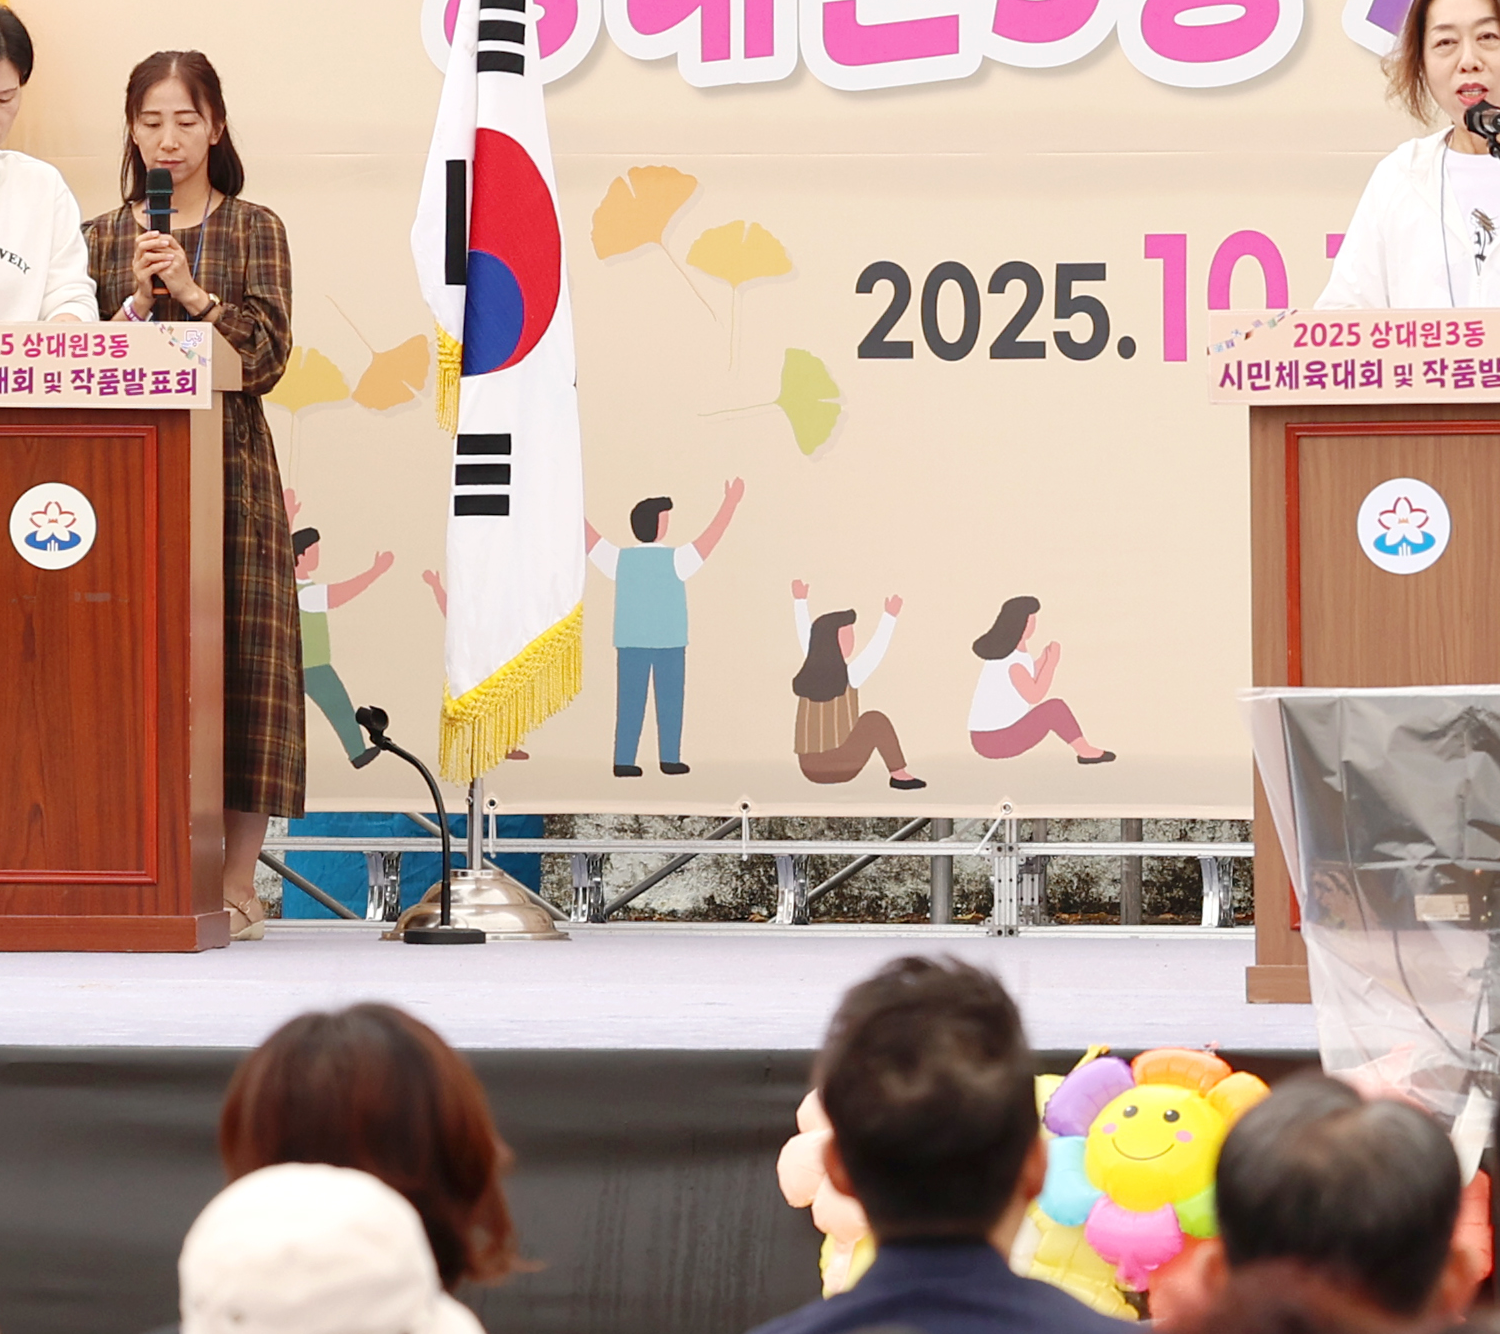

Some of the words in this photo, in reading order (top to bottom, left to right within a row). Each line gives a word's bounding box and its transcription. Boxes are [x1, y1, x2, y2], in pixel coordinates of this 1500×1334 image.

[22, 331, 130, 359] 상대원3동
[1293, 322, 1362, 348] 2025
[1369, 319, 1486, 350] 상대원3동
[44, 371, 63, 394] 및
[70, 366, 198, 397] 작품발표회
[1218, 357, 1384, 392] 시민체육대회
[1393, 363, 1414, 388] 및
